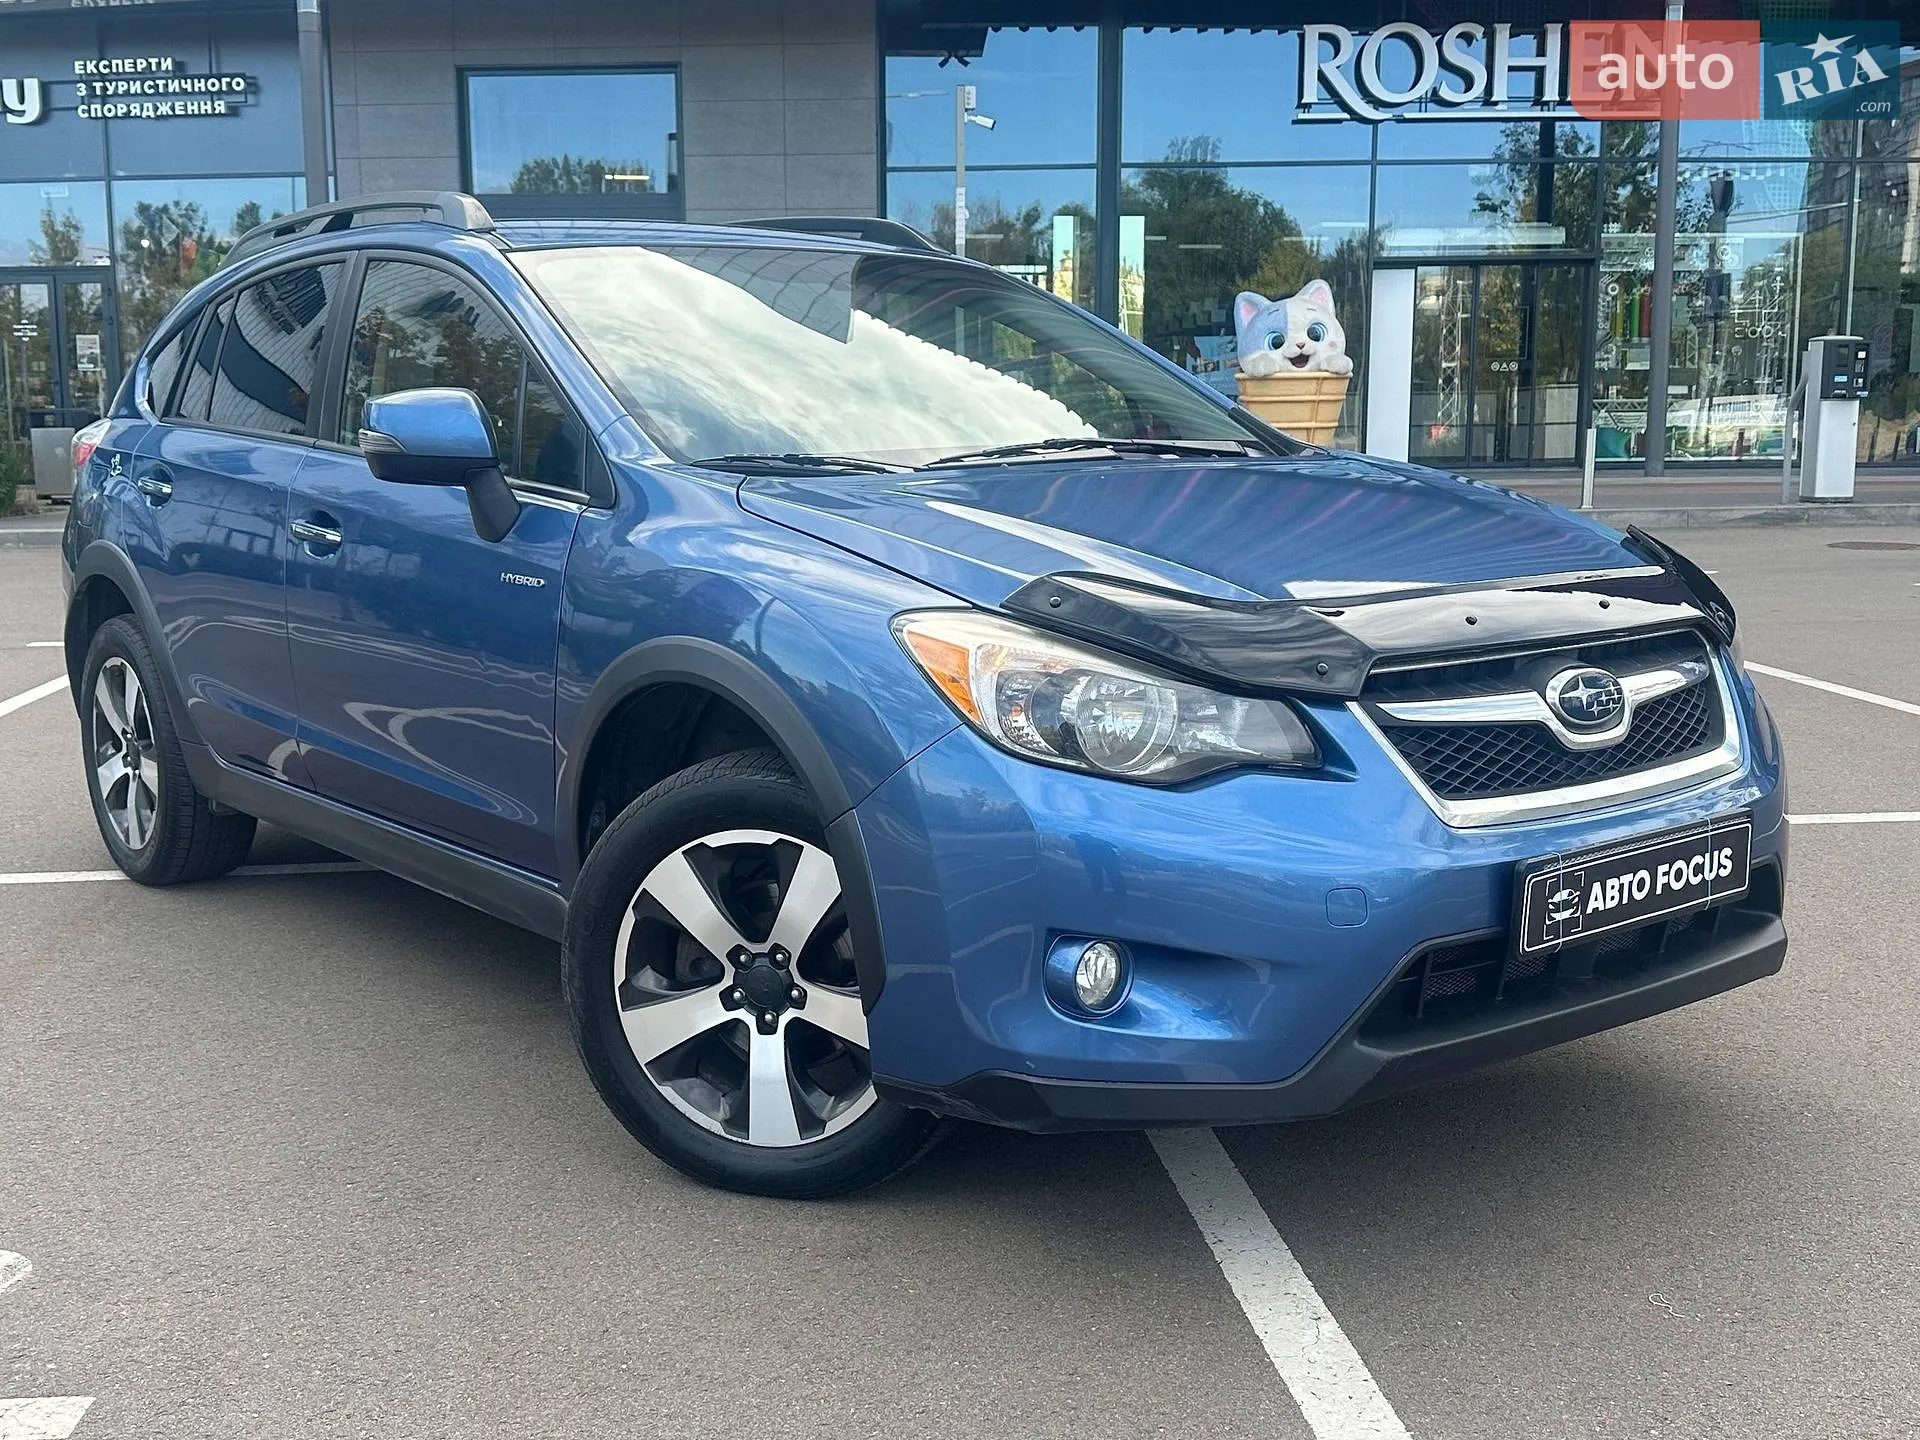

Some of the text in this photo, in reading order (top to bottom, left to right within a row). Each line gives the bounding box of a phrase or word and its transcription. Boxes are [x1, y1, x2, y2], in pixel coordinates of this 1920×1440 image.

[74, 57, 173, 74] ЕКСПЕРТИ
[1300, 22, 1690, 120] ROSHEN
[92, 77, 245, 95] ТУРИСТИЧНОГО
[77, 100, 226, 119] СПОРЯДЖЕННЯ
[500, 572, 545, 587] HYBRID
[1586, 847, 1733, 915] АВТО FOCUS
